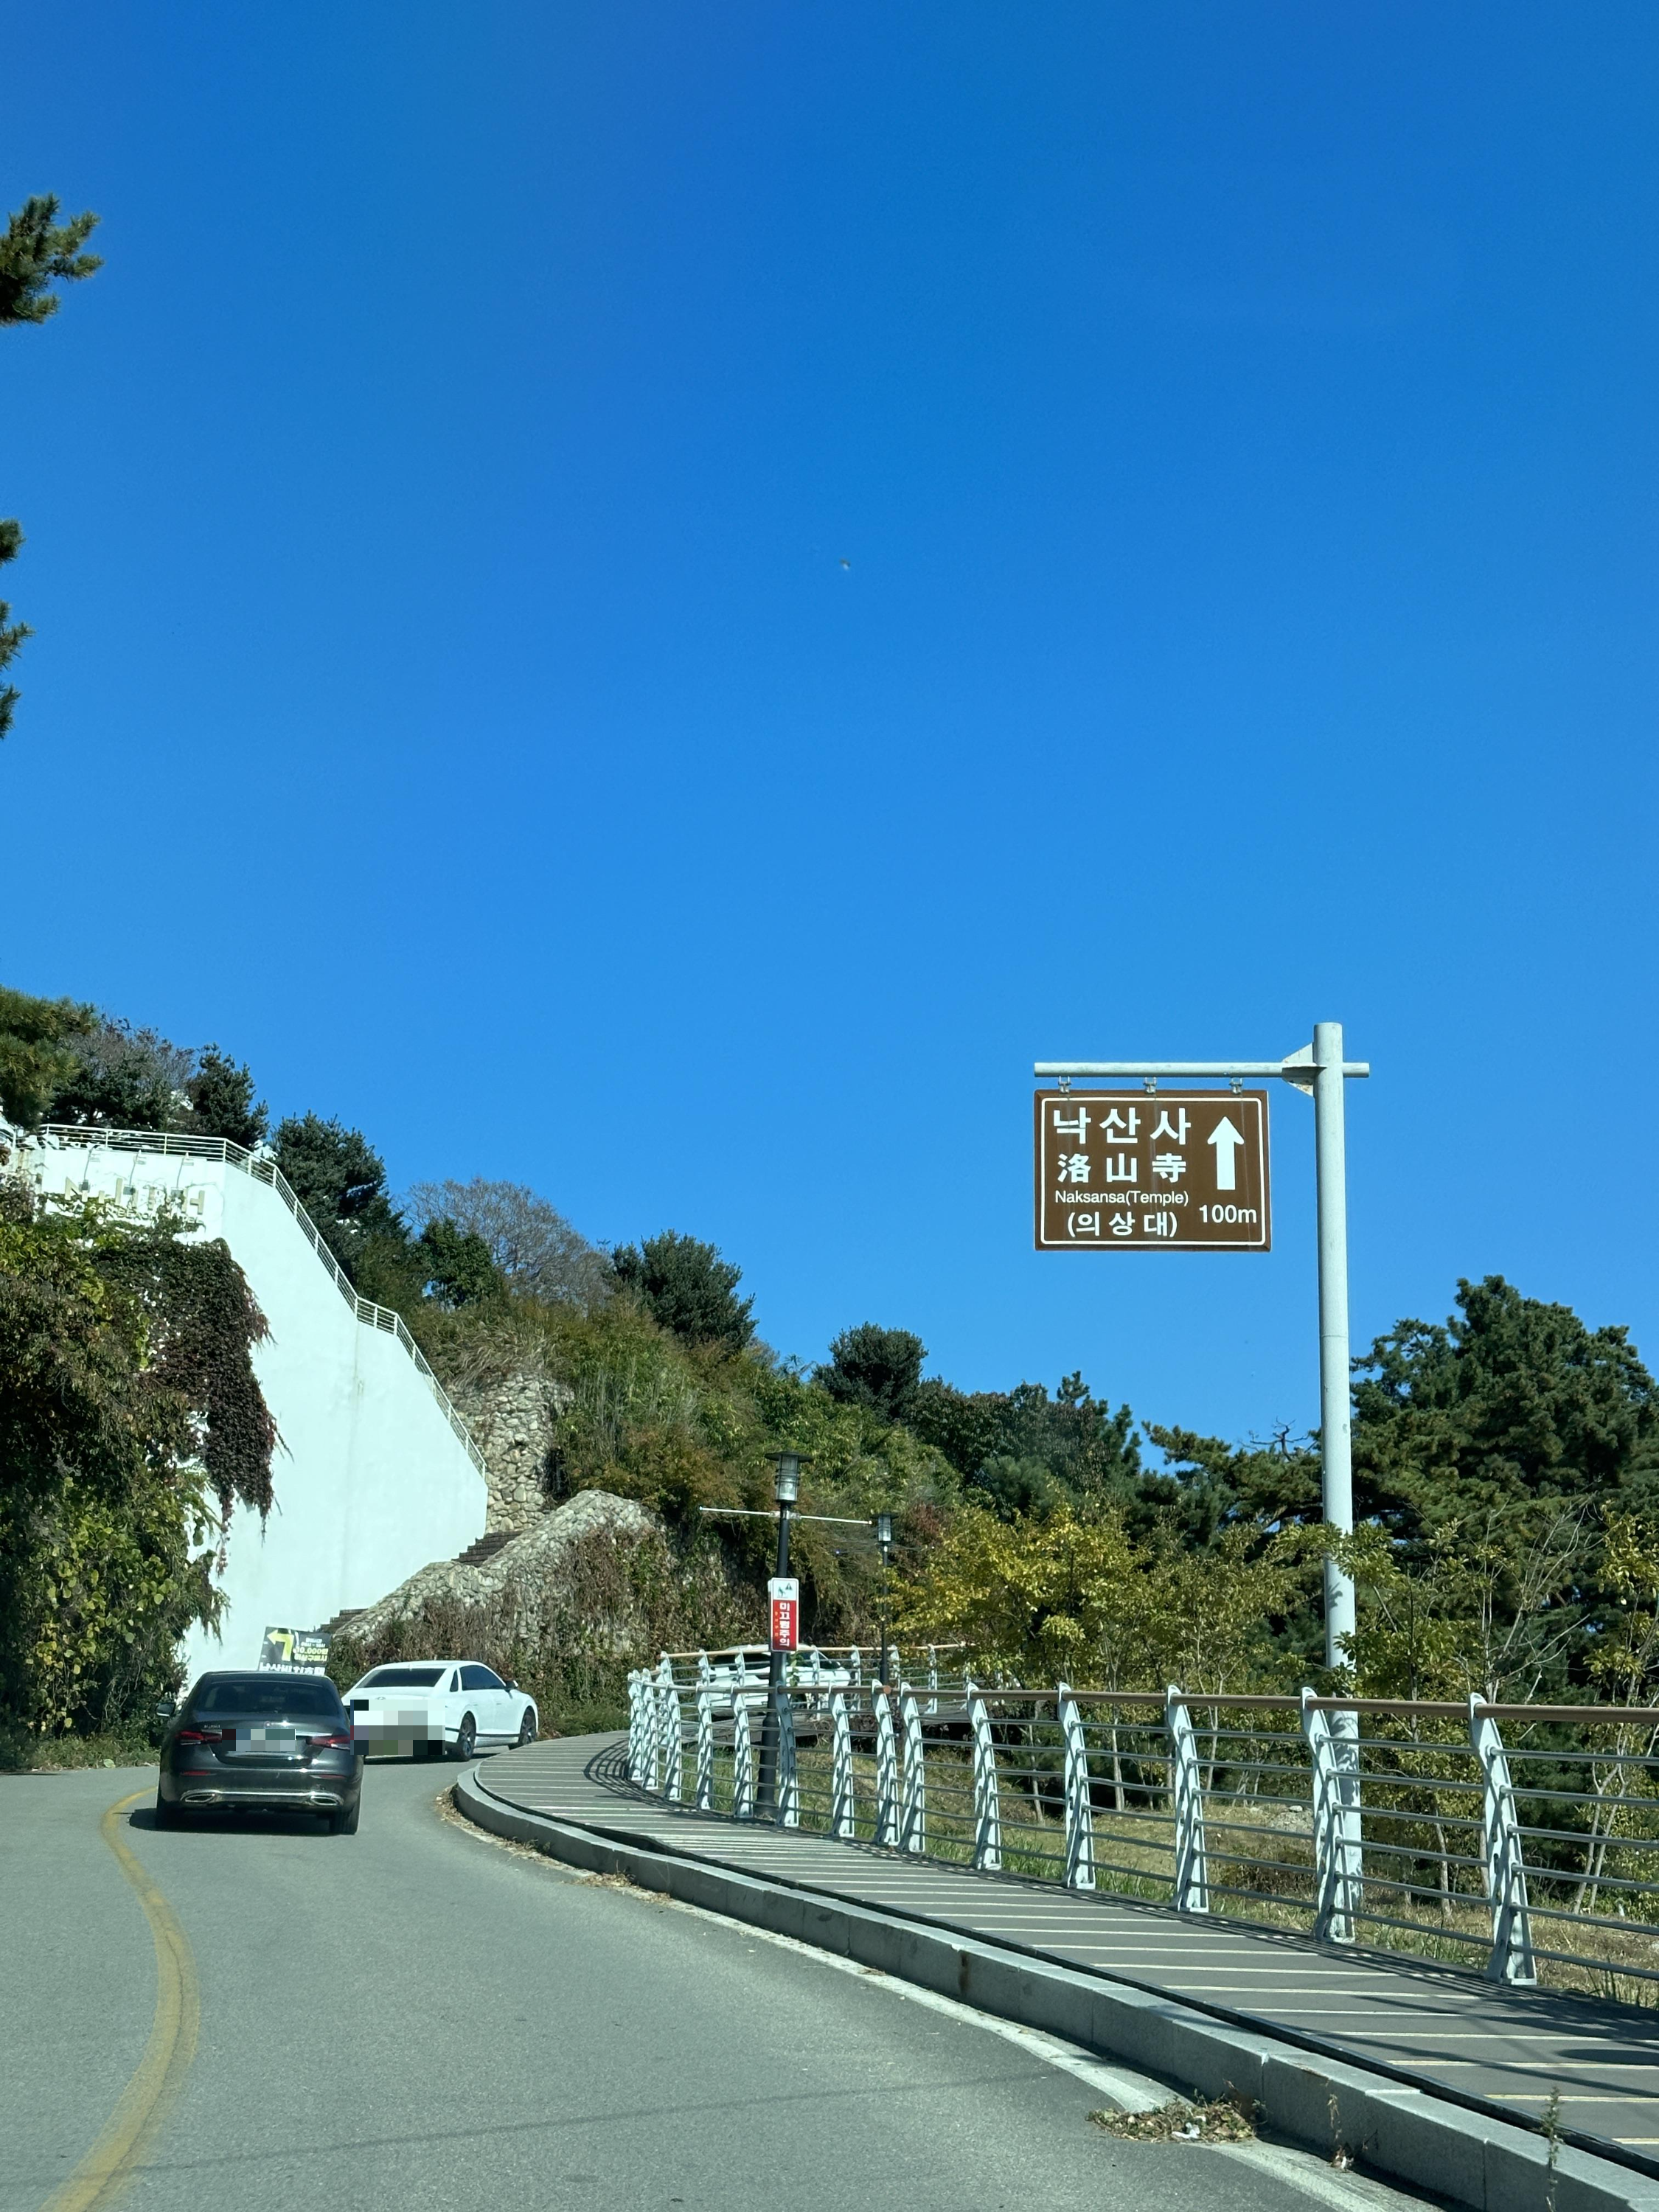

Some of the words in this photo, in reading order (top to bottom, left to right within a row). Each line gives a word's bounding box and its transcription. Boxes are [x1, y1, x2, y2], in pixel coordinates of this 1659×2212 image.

[1053, 1107, 1192, 1145] 낙산사
[1057, 1152, 1187, 1183] 洛山寺
[1054, 1189, 1189, 1207] Naksansa(Temple)
[1067, 1211, 1178, 1238] (의상대)
[1199, 1204, 1257, 1224] 100m
[779, 1602, 790, 1646] 미끄럼주의
